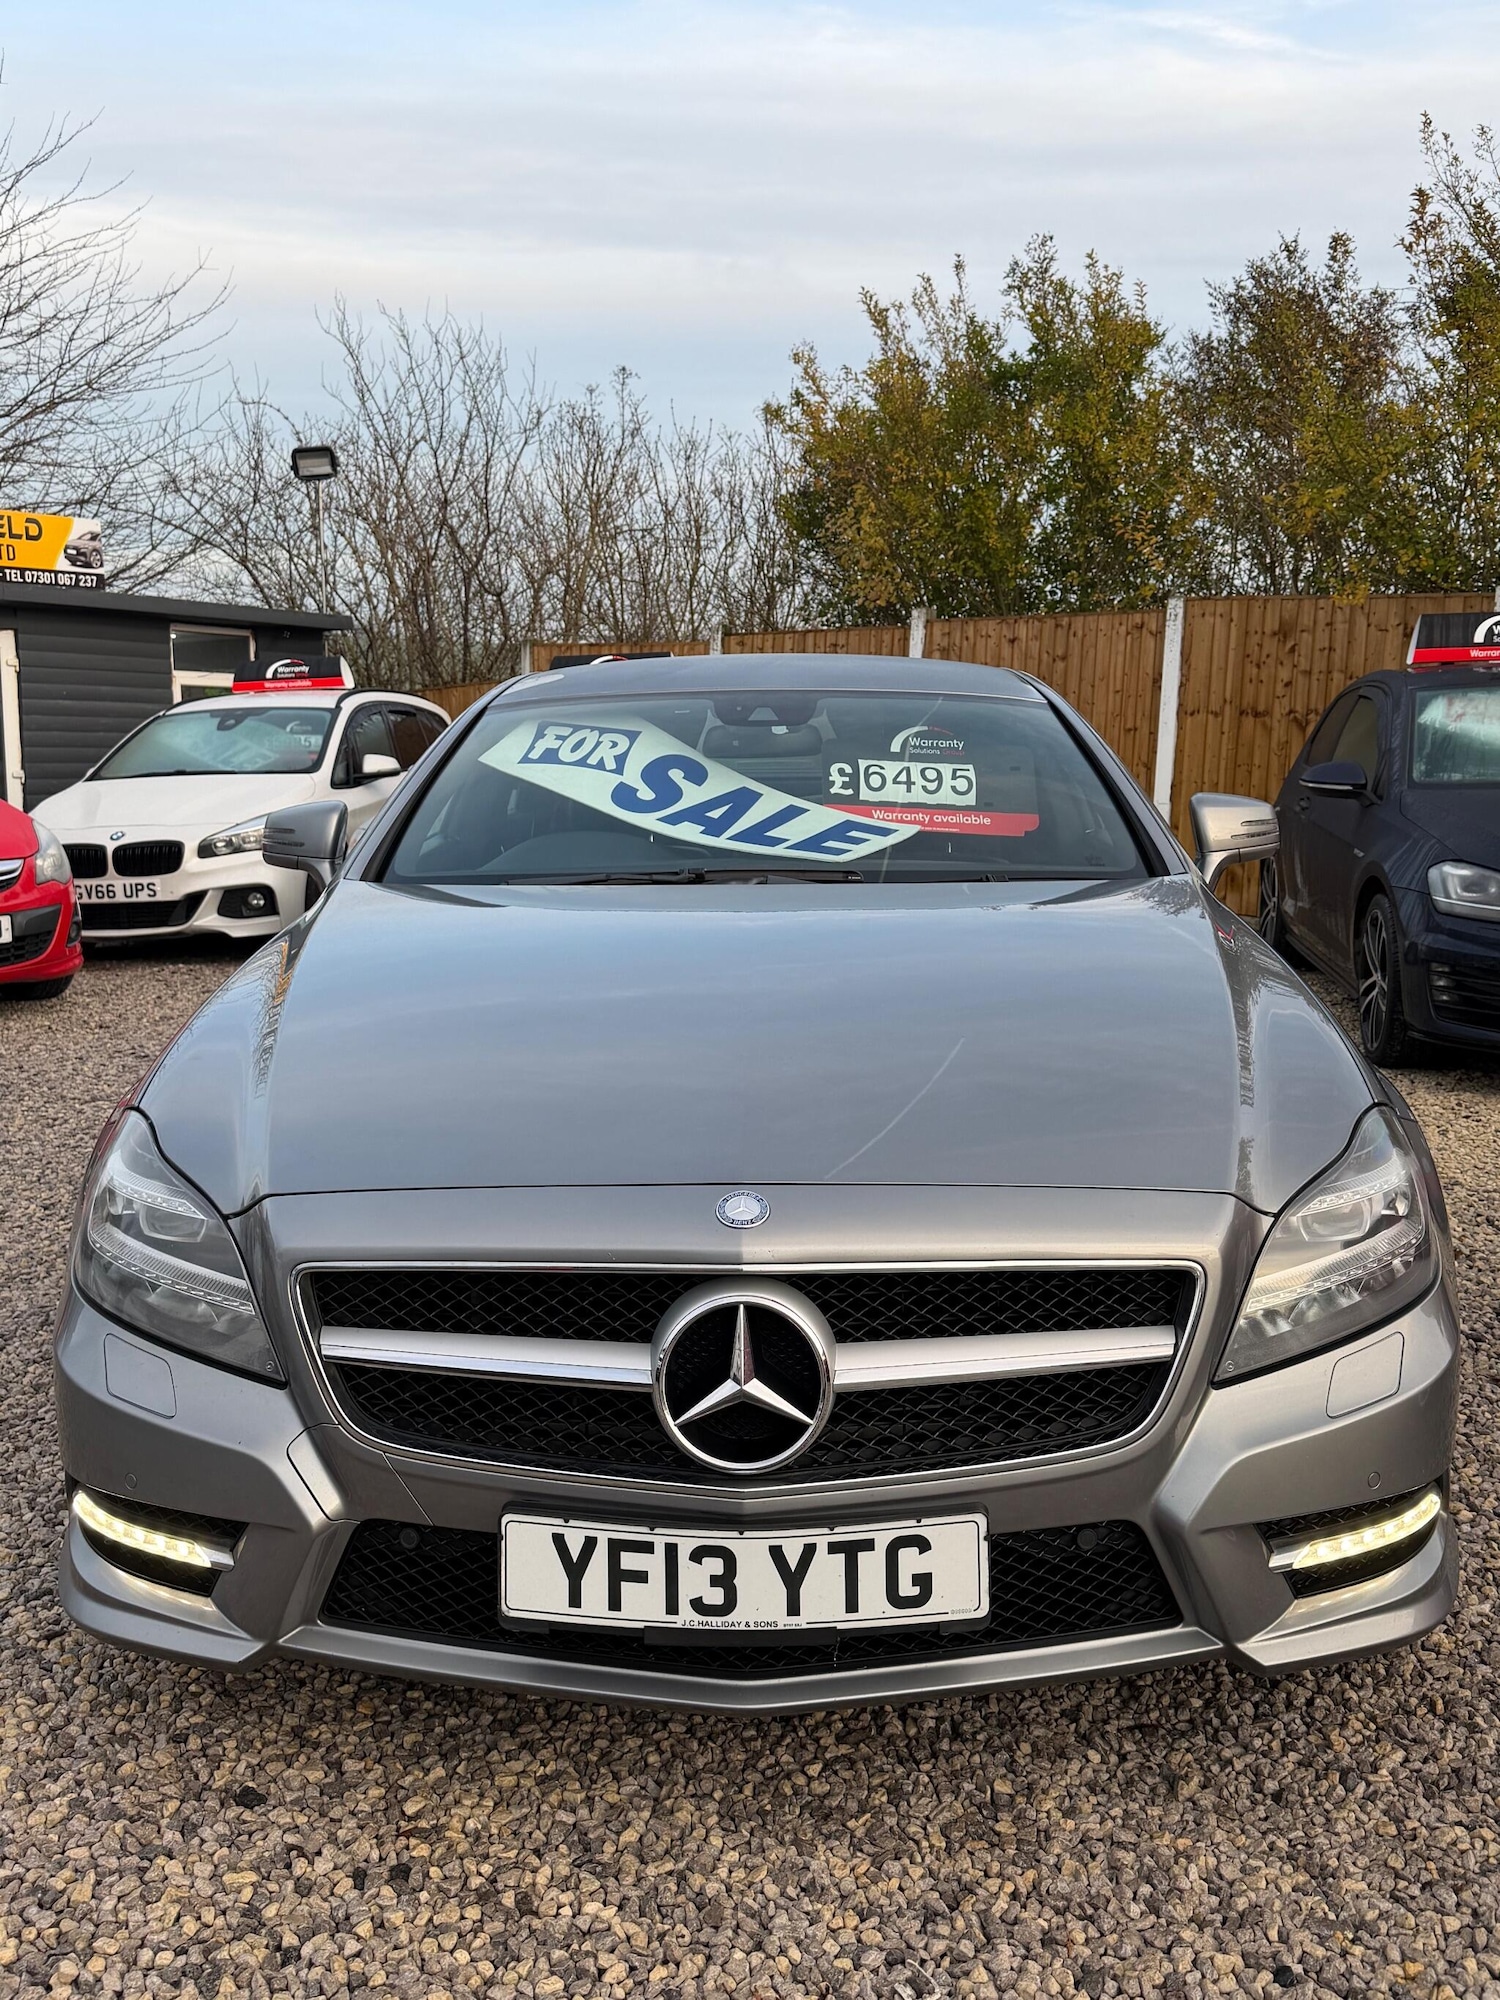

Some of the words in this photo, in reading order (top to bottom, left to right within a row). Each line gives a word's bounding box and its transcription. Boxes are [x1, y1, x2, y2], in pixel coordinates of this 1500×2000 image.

[4, 568, 24, 582] TEL
[25, 570, 56, 585] 07301
[57, 573, 76, 586] 067
[79, 574, 97, 588] 237
[277, 665, 310, 674] Warranty
[908, 737, 964, 751] Warranty
[909, 747, 940, 755] Solutions
[528, 726, 630, 771] FOR
[611, 754, 900, 857] SALE
[872, 809, 930, 828] Warranty
[933, 812, 991, 826] available
[75, 883, 116, 900] GV66
[123, 882, 157, 899] UPS
[551, 1532, 737, 1618] YF13
[768, 1533, 933, 1618] YTG
